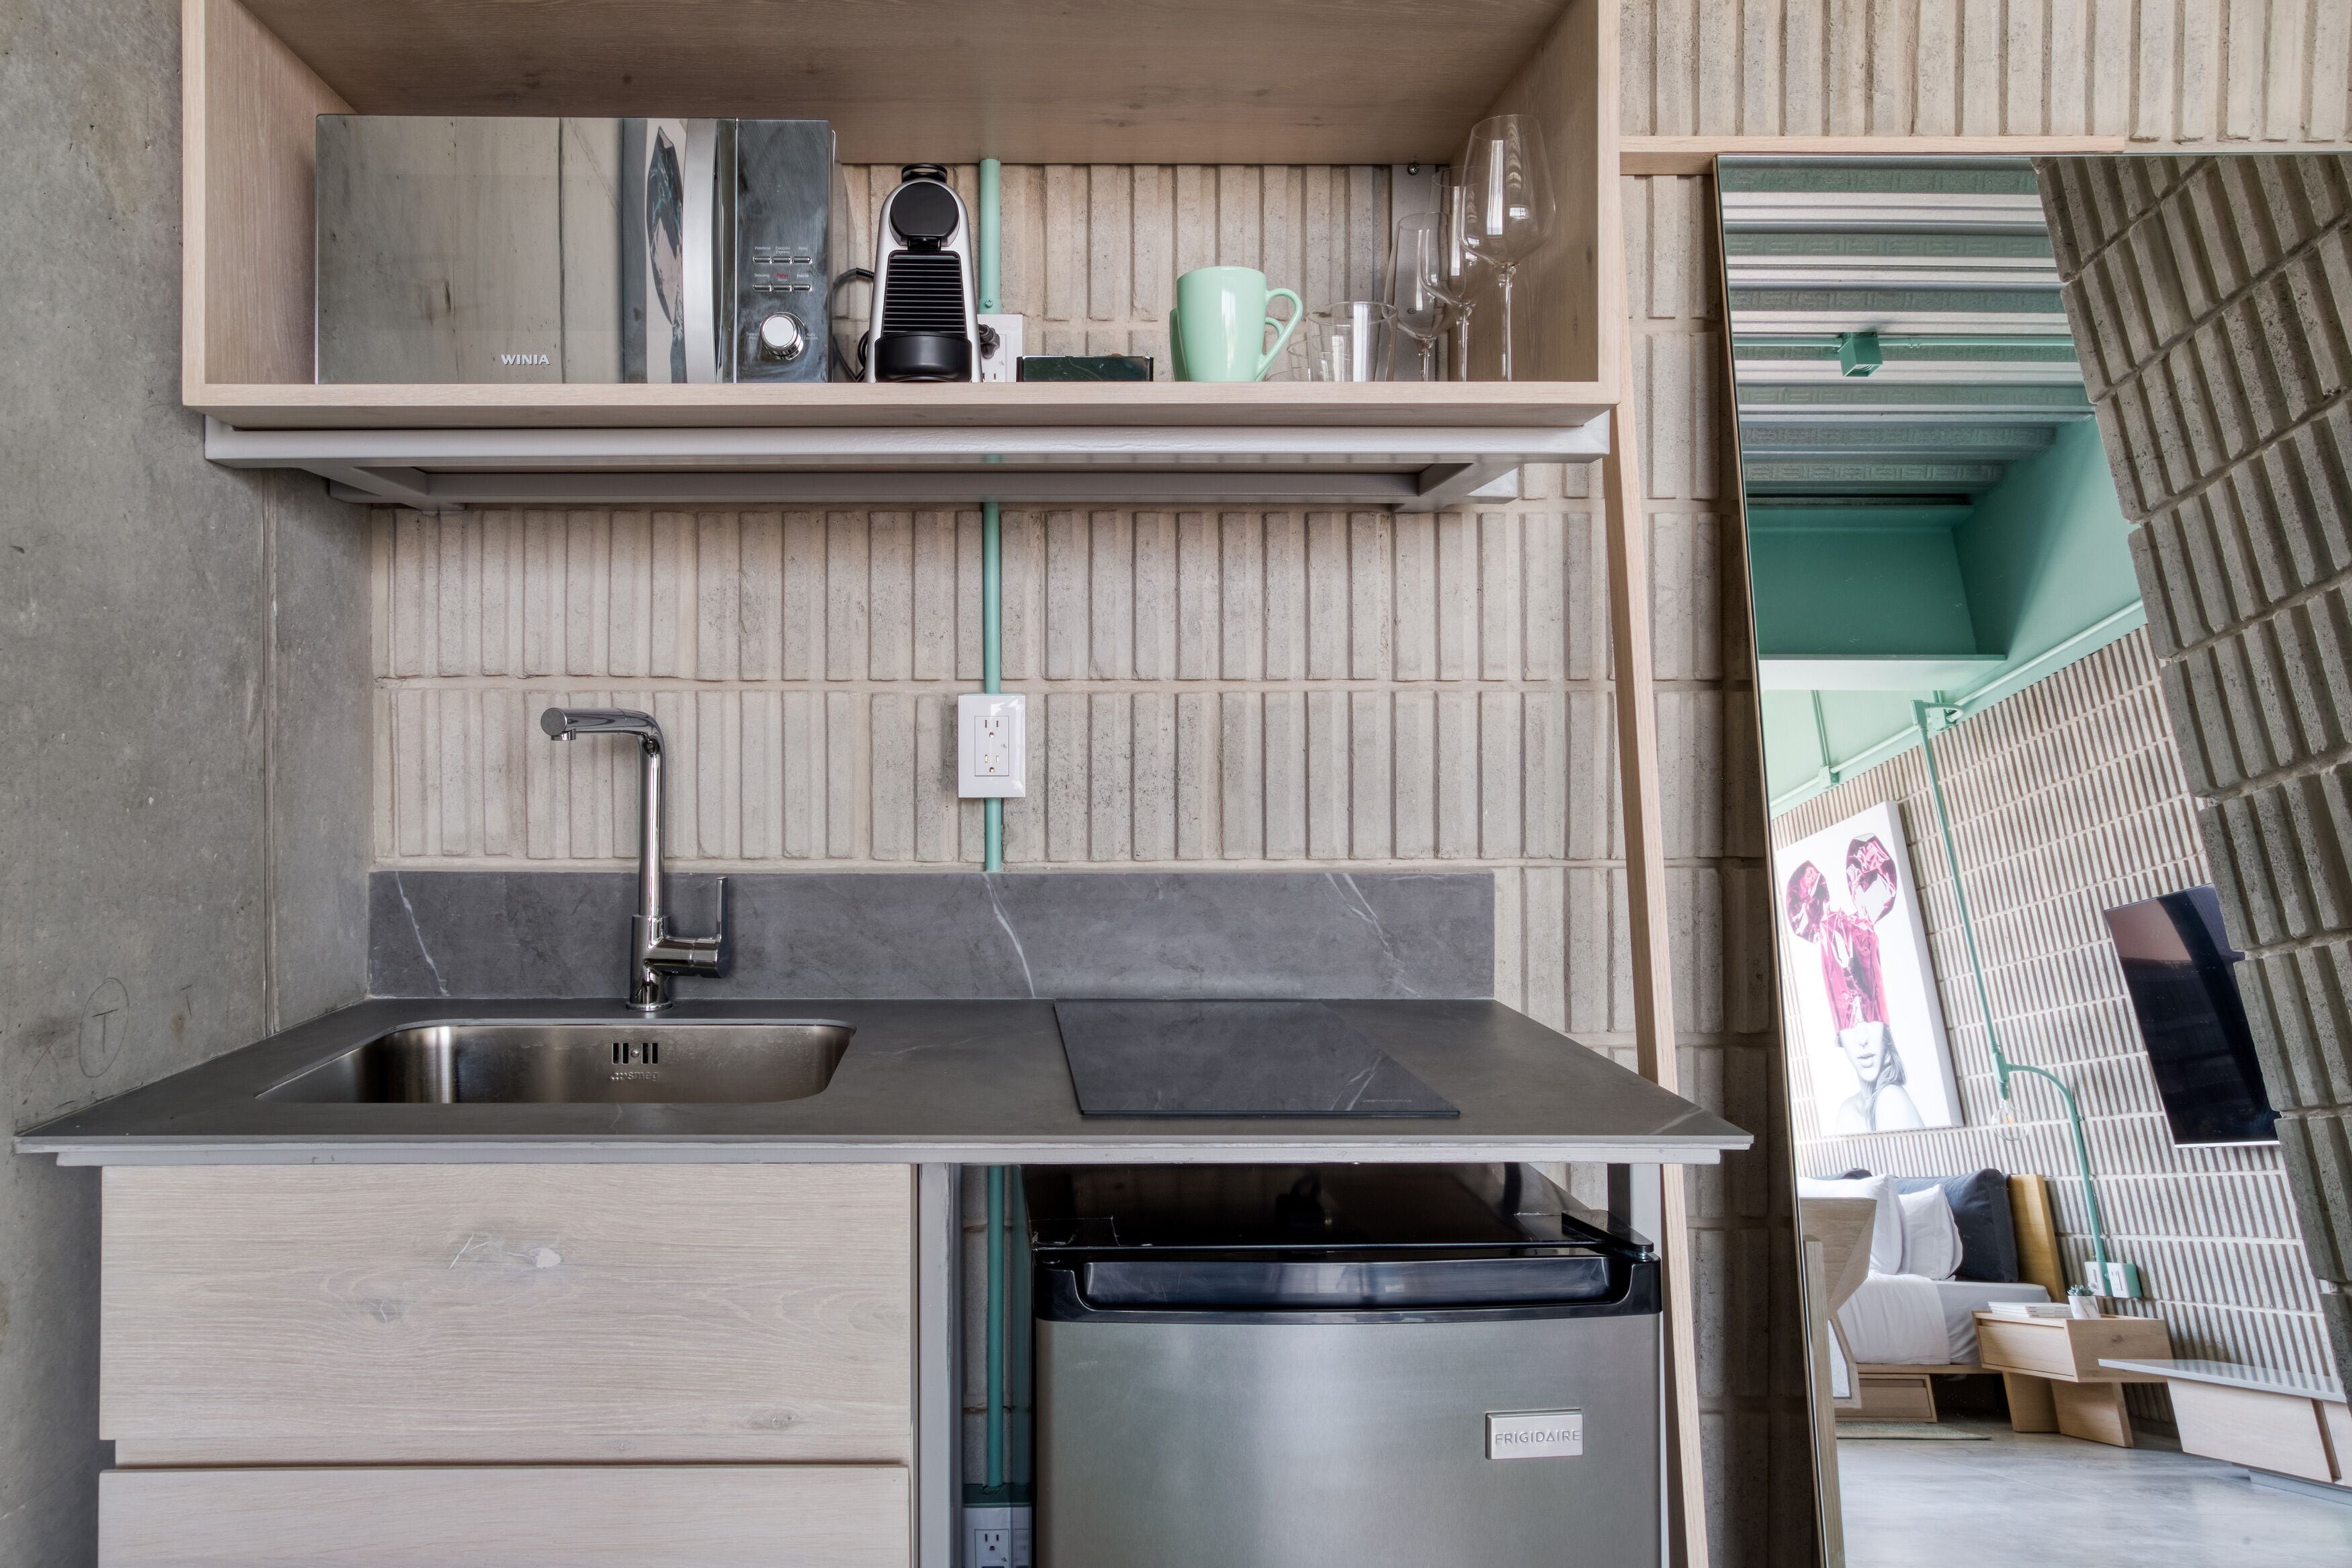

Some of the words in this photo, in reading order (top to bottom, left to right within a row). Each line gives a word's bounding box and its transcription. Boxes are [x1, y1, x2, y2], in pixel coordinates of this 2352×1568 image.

[501, 354, 550, 365] WINIA
[627, 1071, 659, 1082] smeg
[1495, 1430, 1581, 1444] FRIGIDAIRE
